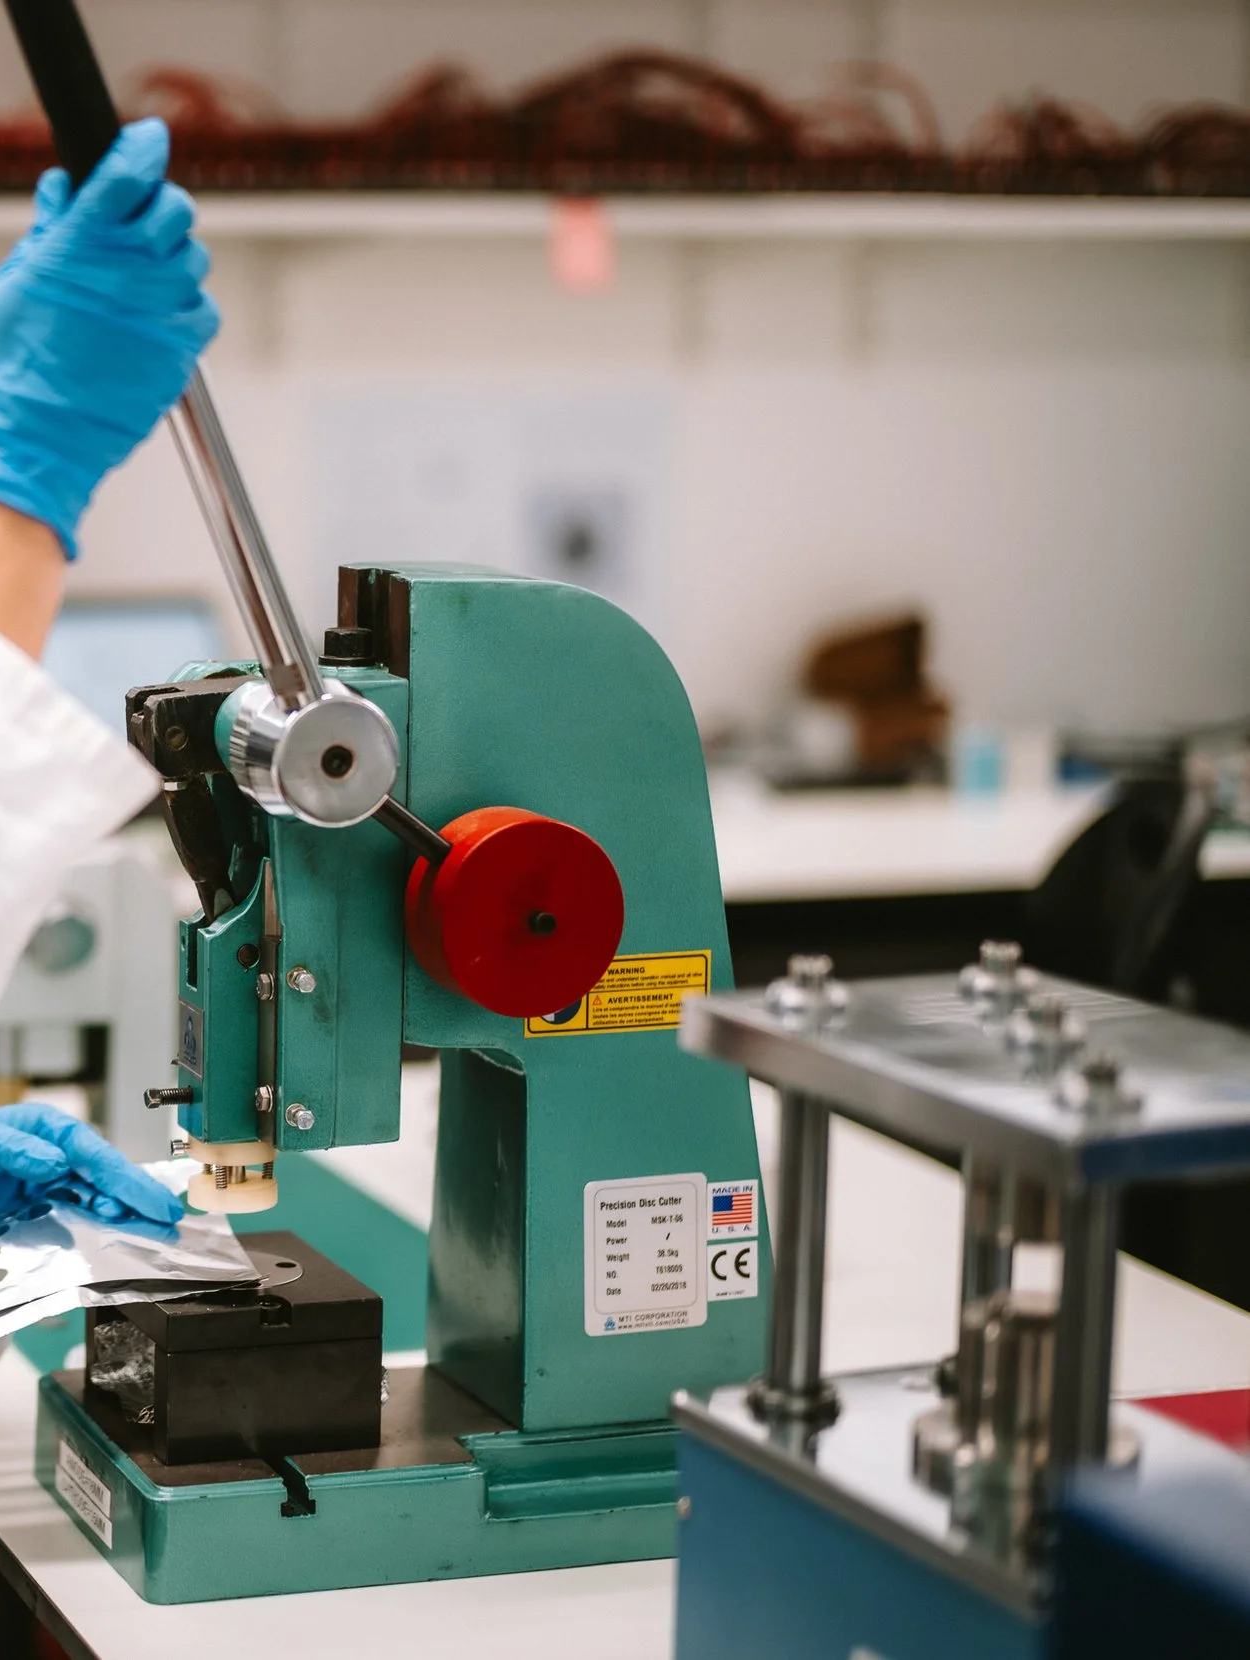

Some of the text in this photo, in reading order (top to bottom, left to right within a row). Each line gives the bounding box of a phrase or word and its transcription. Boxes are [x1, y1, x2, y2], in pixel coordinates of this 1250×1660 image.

[608, 967, 645, 975] WARNING
[608, 994, 673, 1004] AVERTISSEMENT
[712, 1184, 753, 1194] MADE IN
[600, 1196, 682, 1211] Precision Disc Cutter
[606, 1219, 627, 1228] Model
[606, 1237, 627, 1245] Power
[606, 1253, 630, 1262] Weight
[711, 1248, 750, 1281] CE
[606, 1287, 621, 1296] Date
[634, 1311, 688, 1322] CORPORATION
